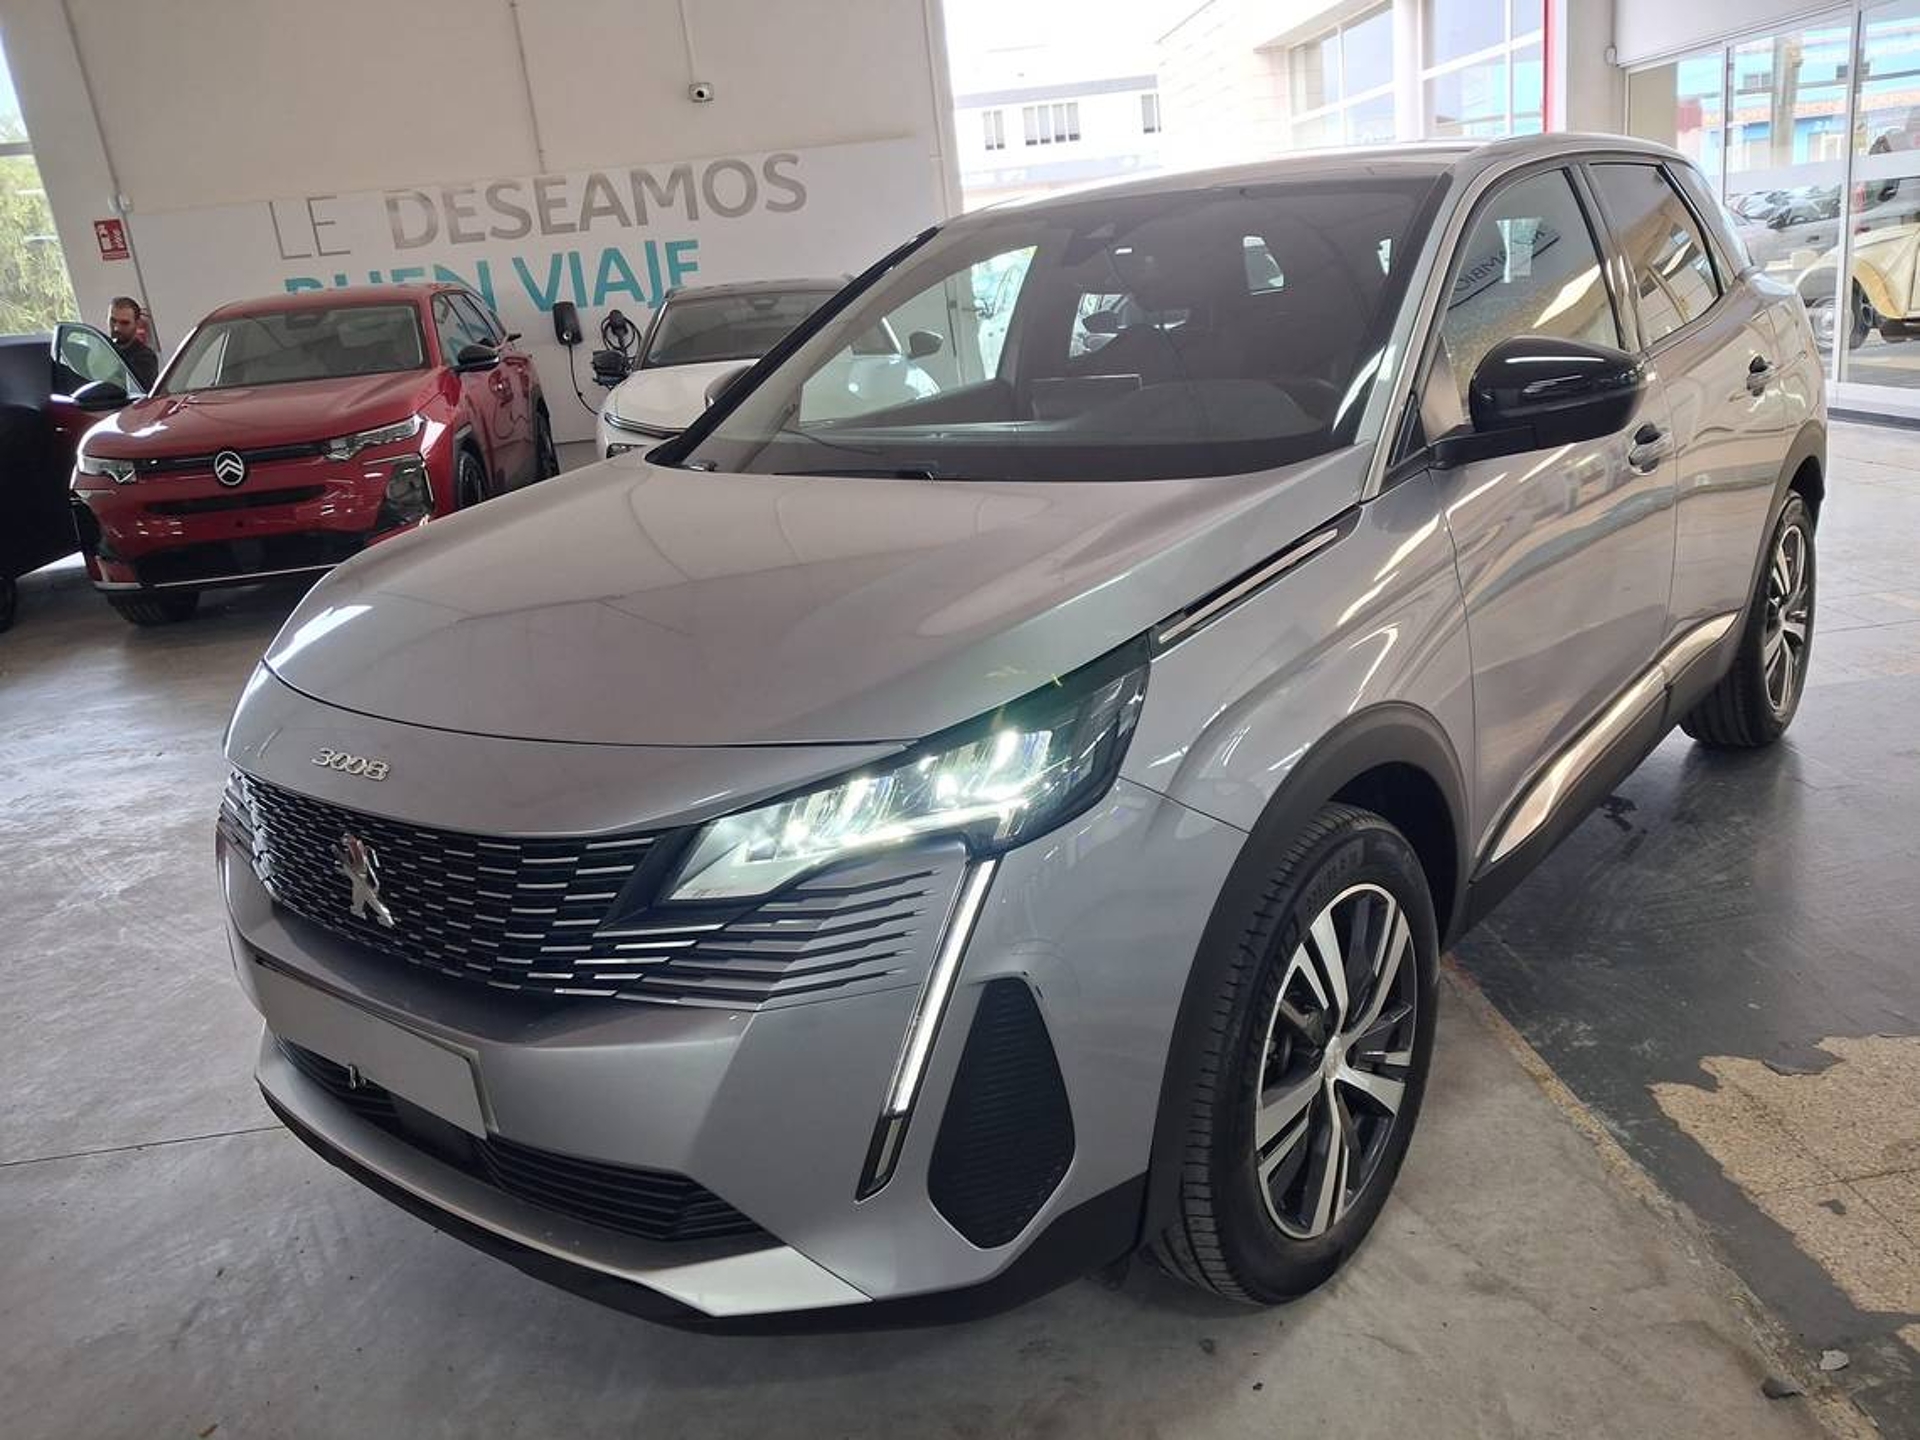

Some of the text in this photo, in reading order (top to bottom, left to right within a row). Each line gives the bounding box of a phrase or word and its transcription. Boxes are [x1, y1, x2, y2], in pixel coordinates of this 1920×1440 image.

[268, 152, 808, 260] LE DESEAMOS
[310, 746, 390, 781] 3008
